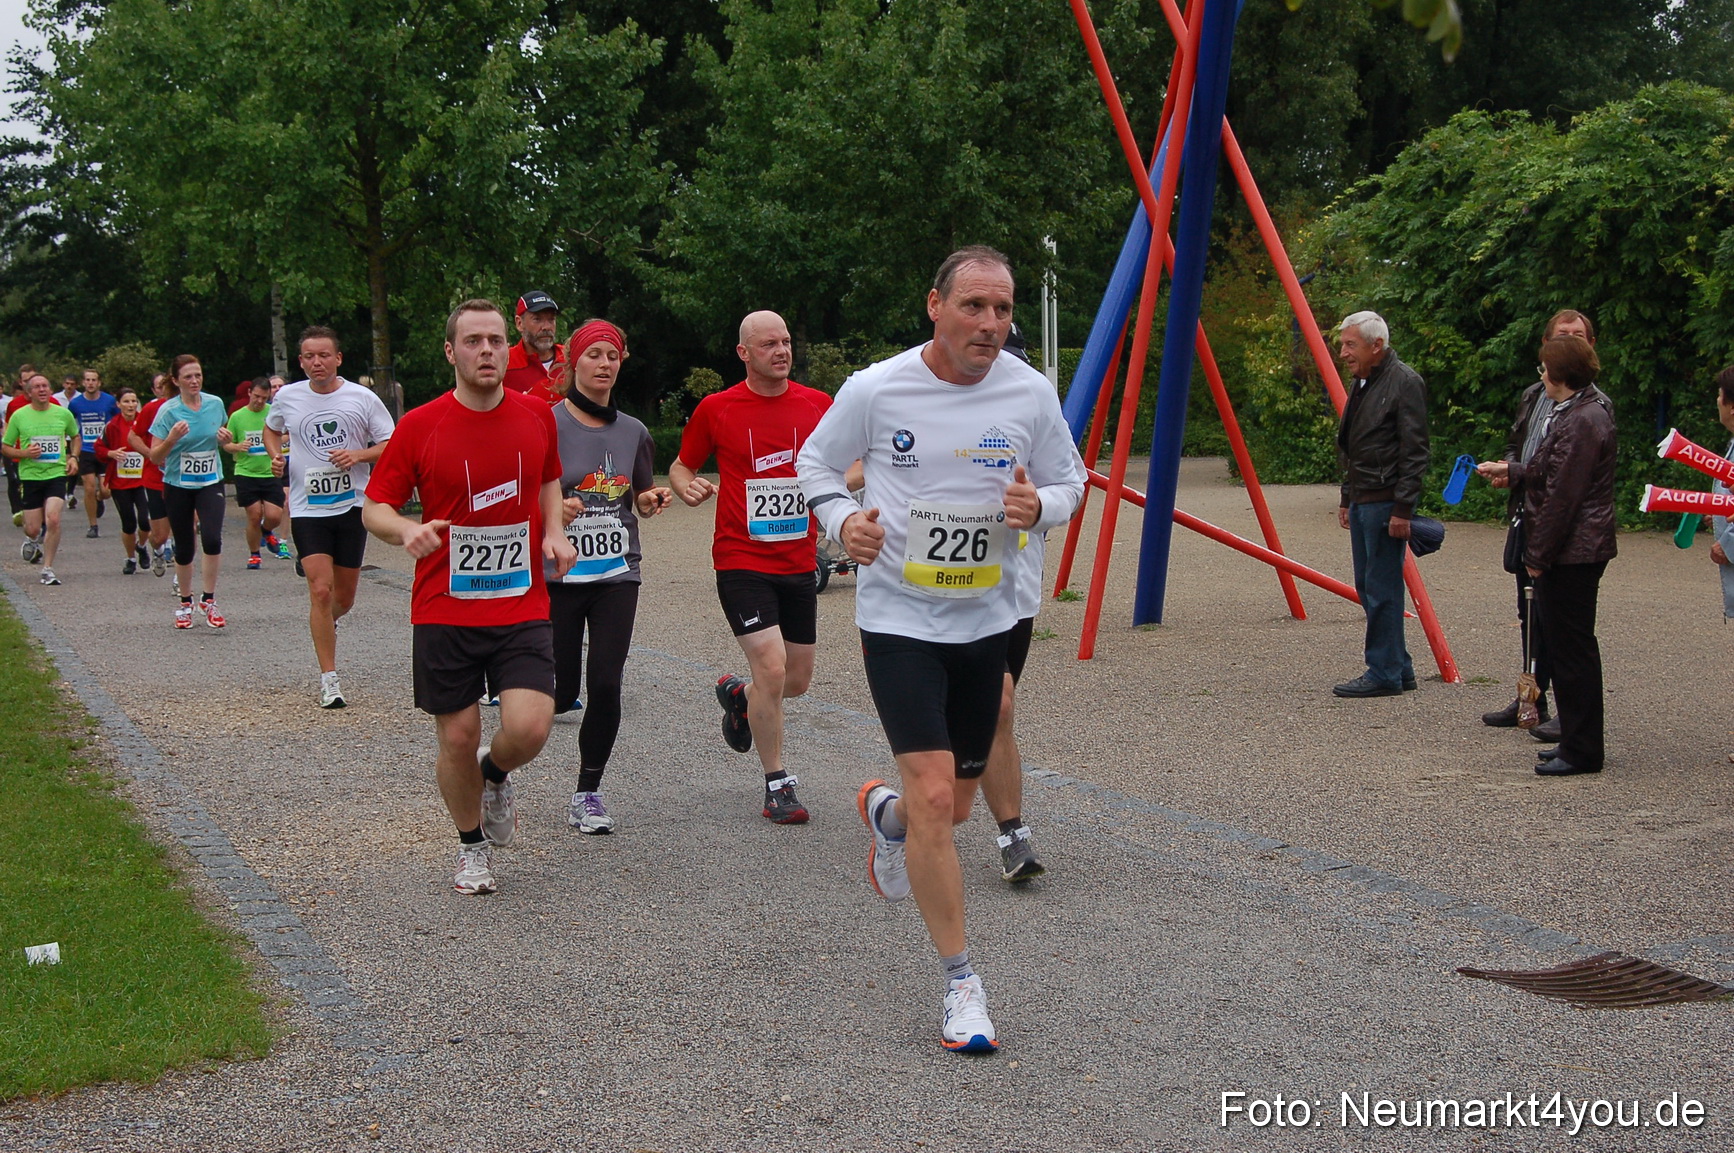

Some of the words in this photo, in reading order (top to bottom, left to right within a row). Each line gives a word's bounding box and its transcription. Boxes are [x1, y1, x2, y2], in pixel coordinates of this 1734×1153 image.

[316, 435, 344, 447] JACOB
[766, 455, 783, 466] DEHN
[891, 454, 919, 463] PARTL
[1678, 444, 1725, 473] Audi
[184, 459, 214, 473] 2667
[310, 474, 352, 494] 3079
[485, 488, 506, 502] DEHN
[1657, 489, 1706, 504] Audi
[754, 492, 805, 518] 2328
[910, 509, 945, 522] PARTL
[947, 514, 993, 523] Neumarkt
[562, 524, 582, 532] ARTL
[583, 522, 616, 530] Neumarkt
[768, 522, 796, 533] Robert
[451, 532, 479, 541] PARTL
[480, 531, 517, 542] Neumarkt
[927, 527, 989, 562] 226
[458, 541, 523, 571] 2272
[470, 576, 511, 589] Michael
[935, 571, 974, 585] Bernd
